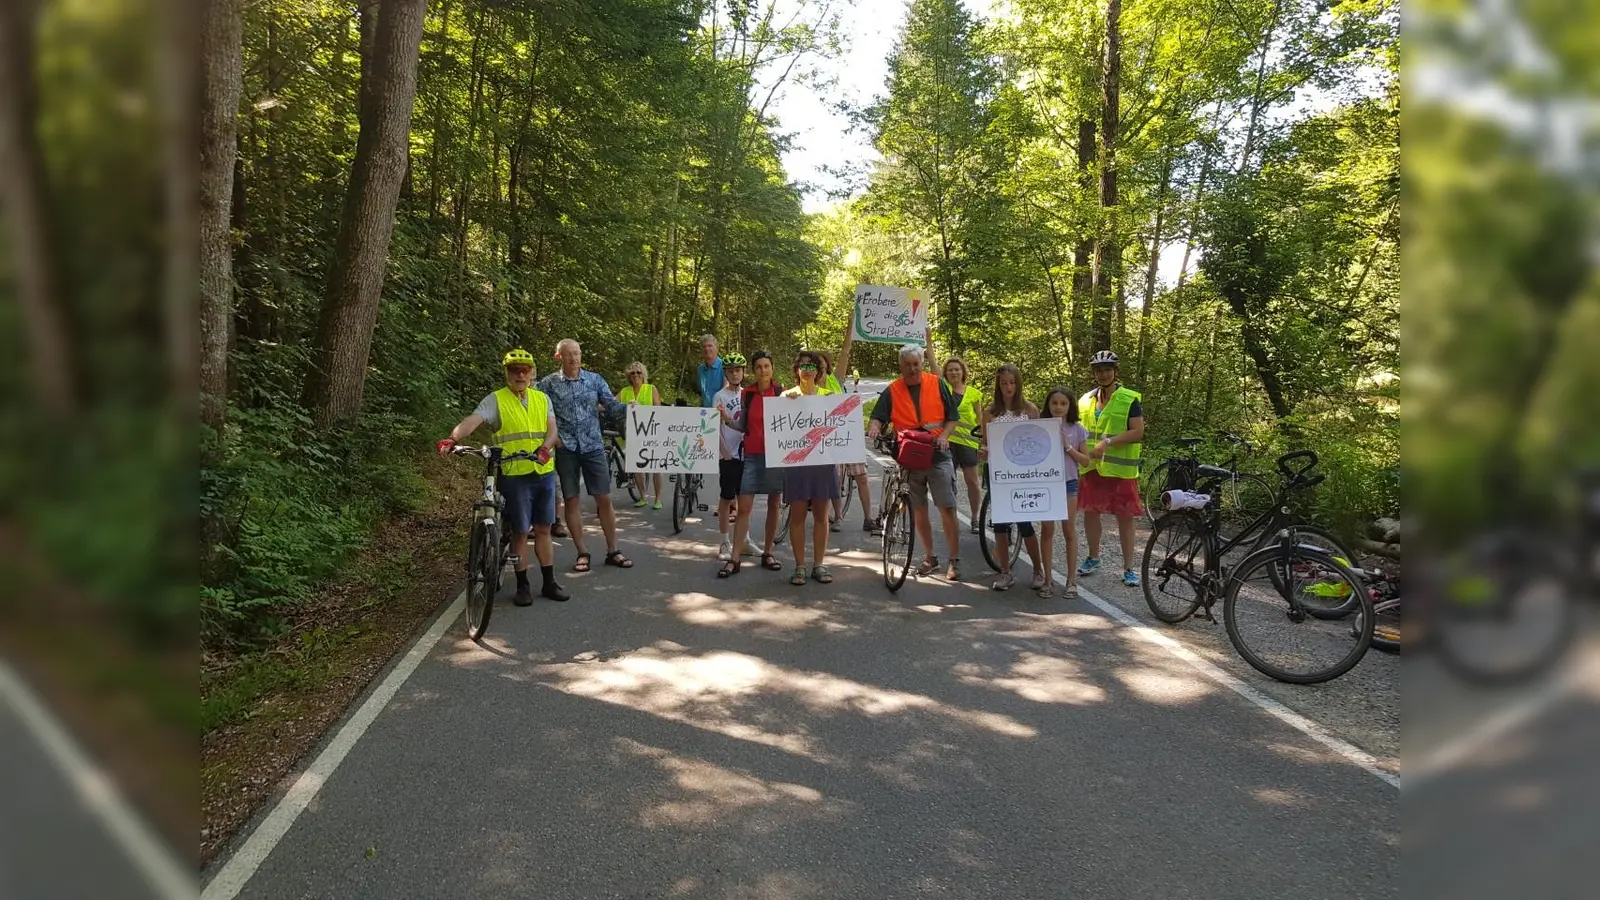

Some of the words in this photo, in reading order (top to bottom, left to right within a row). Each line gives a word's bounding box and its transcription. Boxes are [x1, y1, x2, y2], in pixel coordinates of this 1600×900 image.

[864, 309, 876, 318] Dir
[864, 321, 900, 338] Straße
[632, 411, 660, 436] Wir
[668, 421, 702, 433] erobern
[770, 410, 856, 432] #Verkehrs-
[642, 439, 659, 447] uns
[663, 437, 678, 447] die
[778, 434, 811, 450] wende
[819, 431, 853, 455] jetzt
[636, 448, 680, 470] Straße
[994, 468, 1060, 481] Fahrradstraße
[1013, 491, 1047, 500] Anlieger
[1020, 500, 1039, 509] frei
